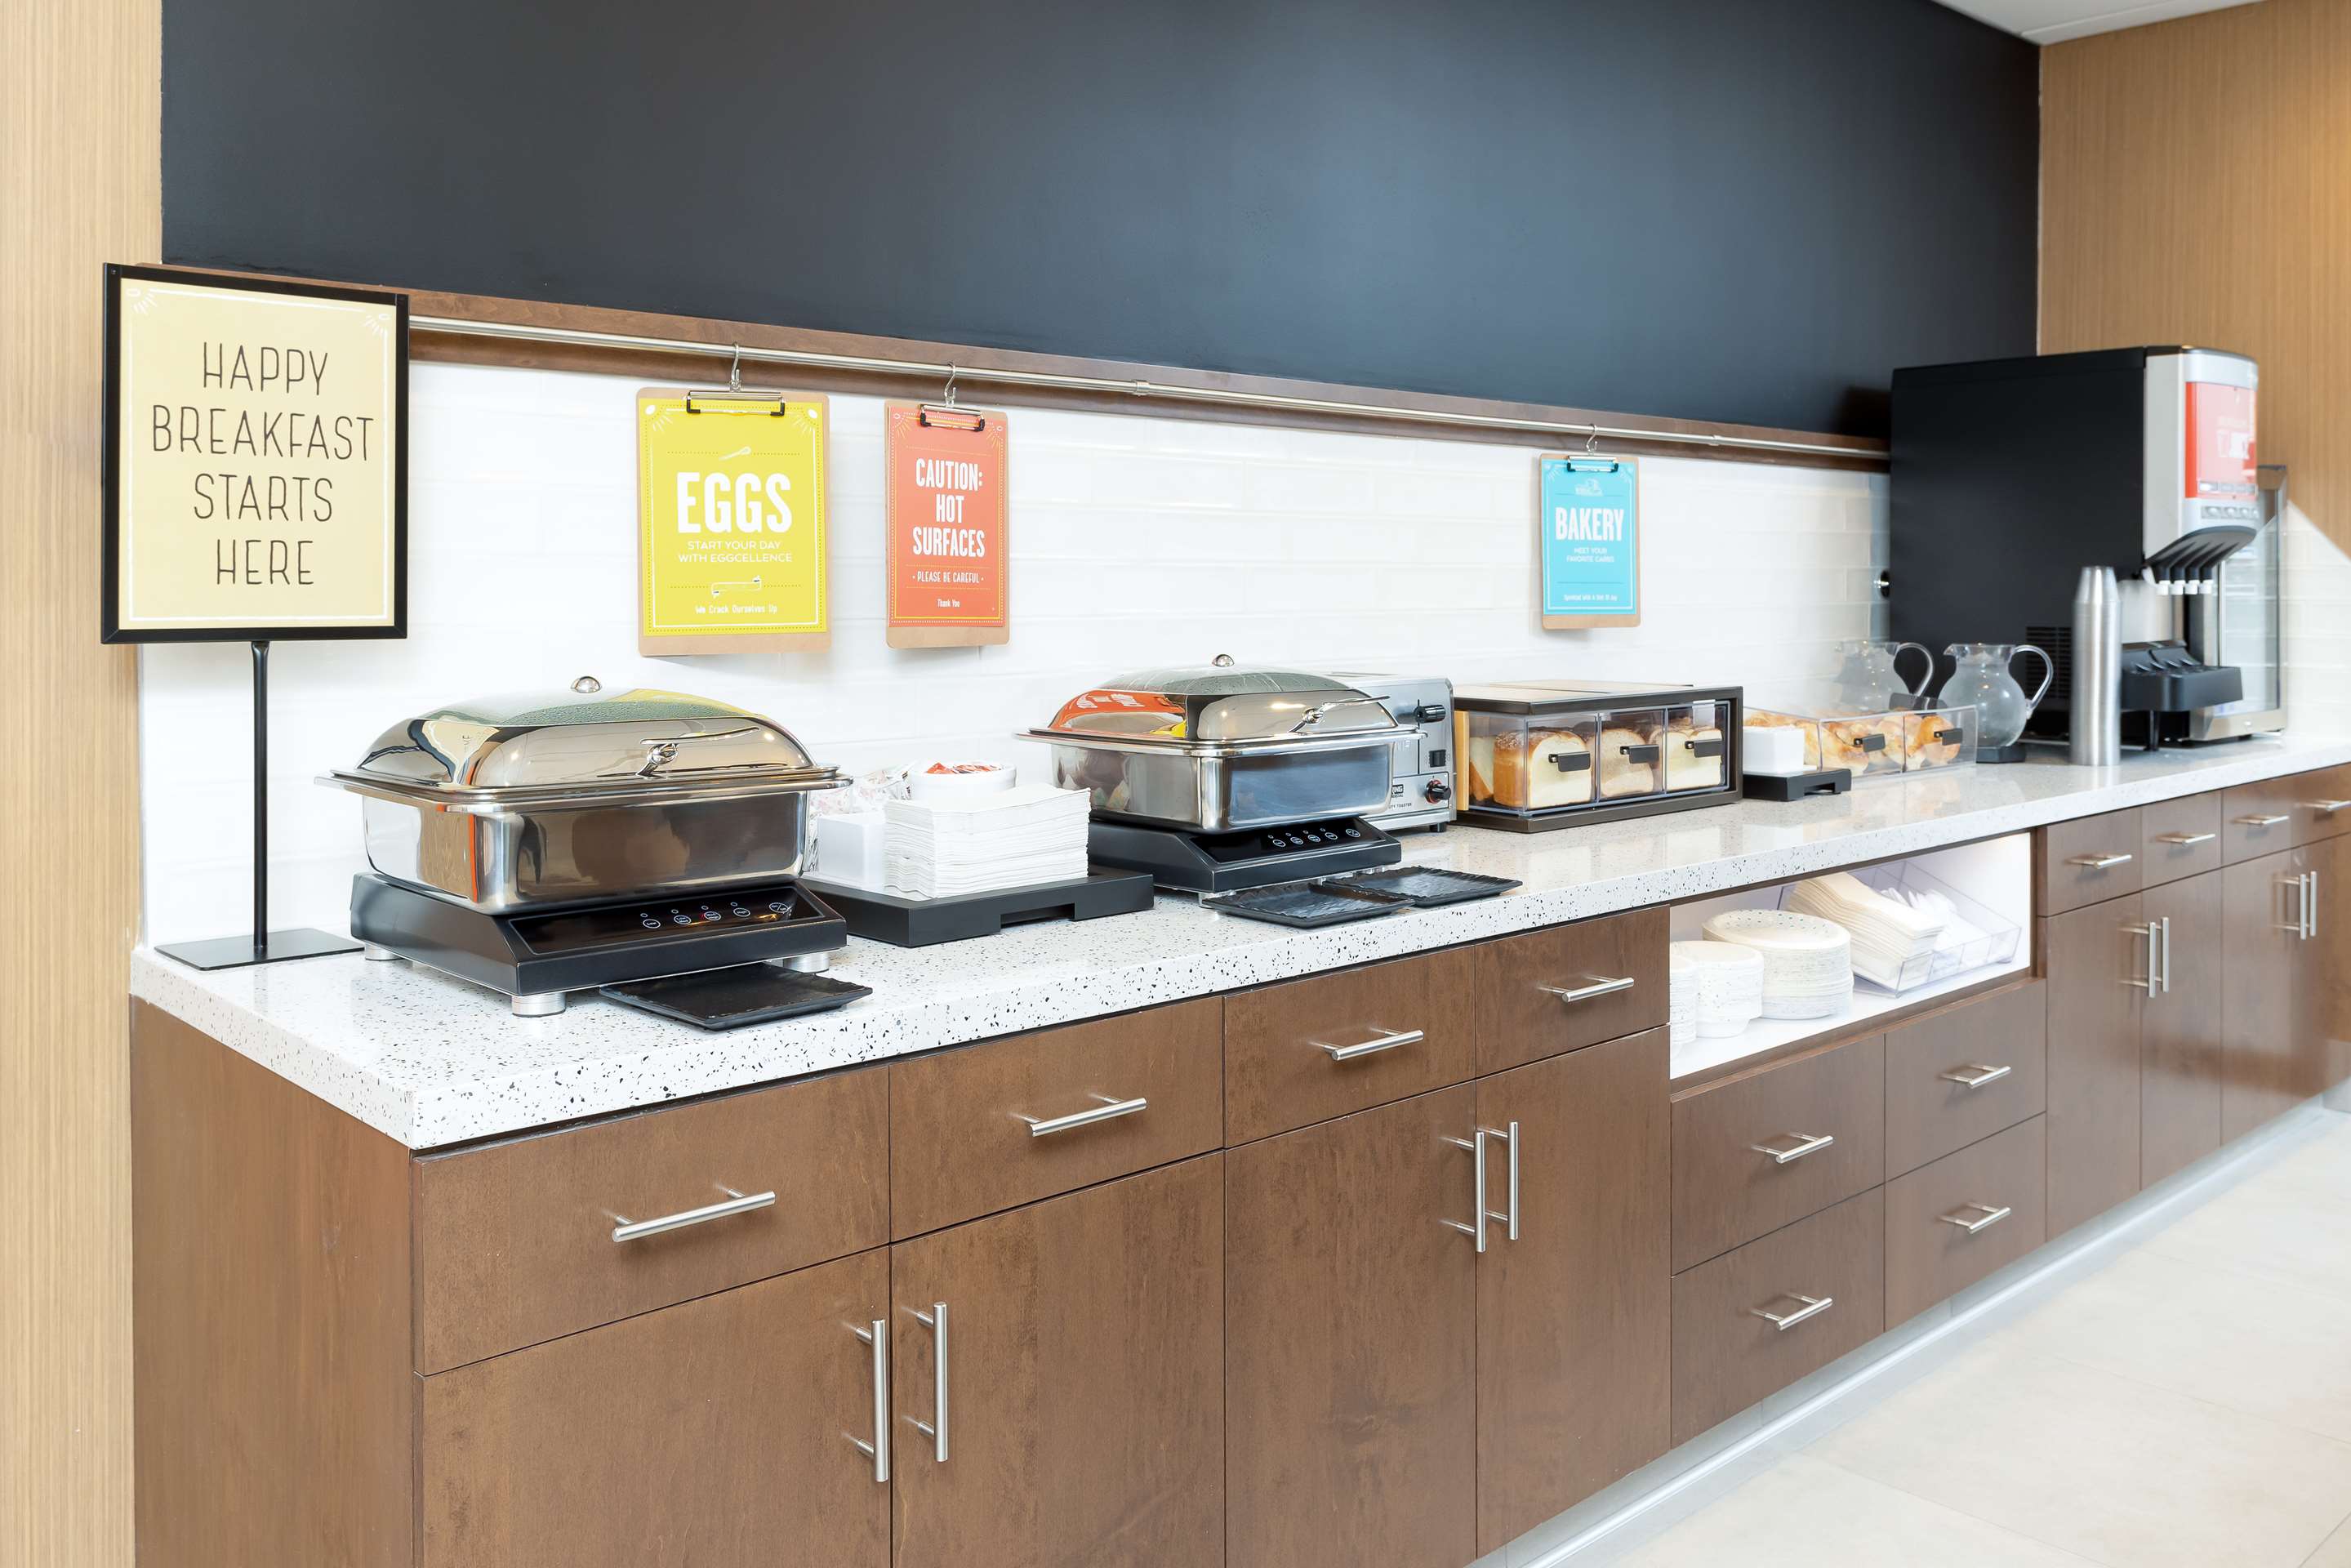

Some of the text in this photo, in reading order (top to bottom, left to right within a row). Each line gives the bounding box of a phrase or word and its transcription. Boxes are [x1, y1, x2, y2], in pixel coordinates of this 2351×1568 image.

[203, 341, 328, 396] HAPPY
[153, 404, 374, 461] BREAKFAST
[915, 457, 982, 492] CAUTION:
[194, 473, 332, 523] STARTS
[676, 471, 793, 534] EGGS
[936, 493, 965, 523] HOT
[1555, 506, 1624, 541] BAKERY
[679, 552, 792, 563] WITH EGGCELLENCE
[688, 540, 781, 550] START YOUR DAY
[912, 526, 986, 558] SURFACES
[216, 539, 314, 586] HERE
[917, 571, 980, 584] PLEASE BE CAREFUL
[937, 598, 960, 608] Thank You
